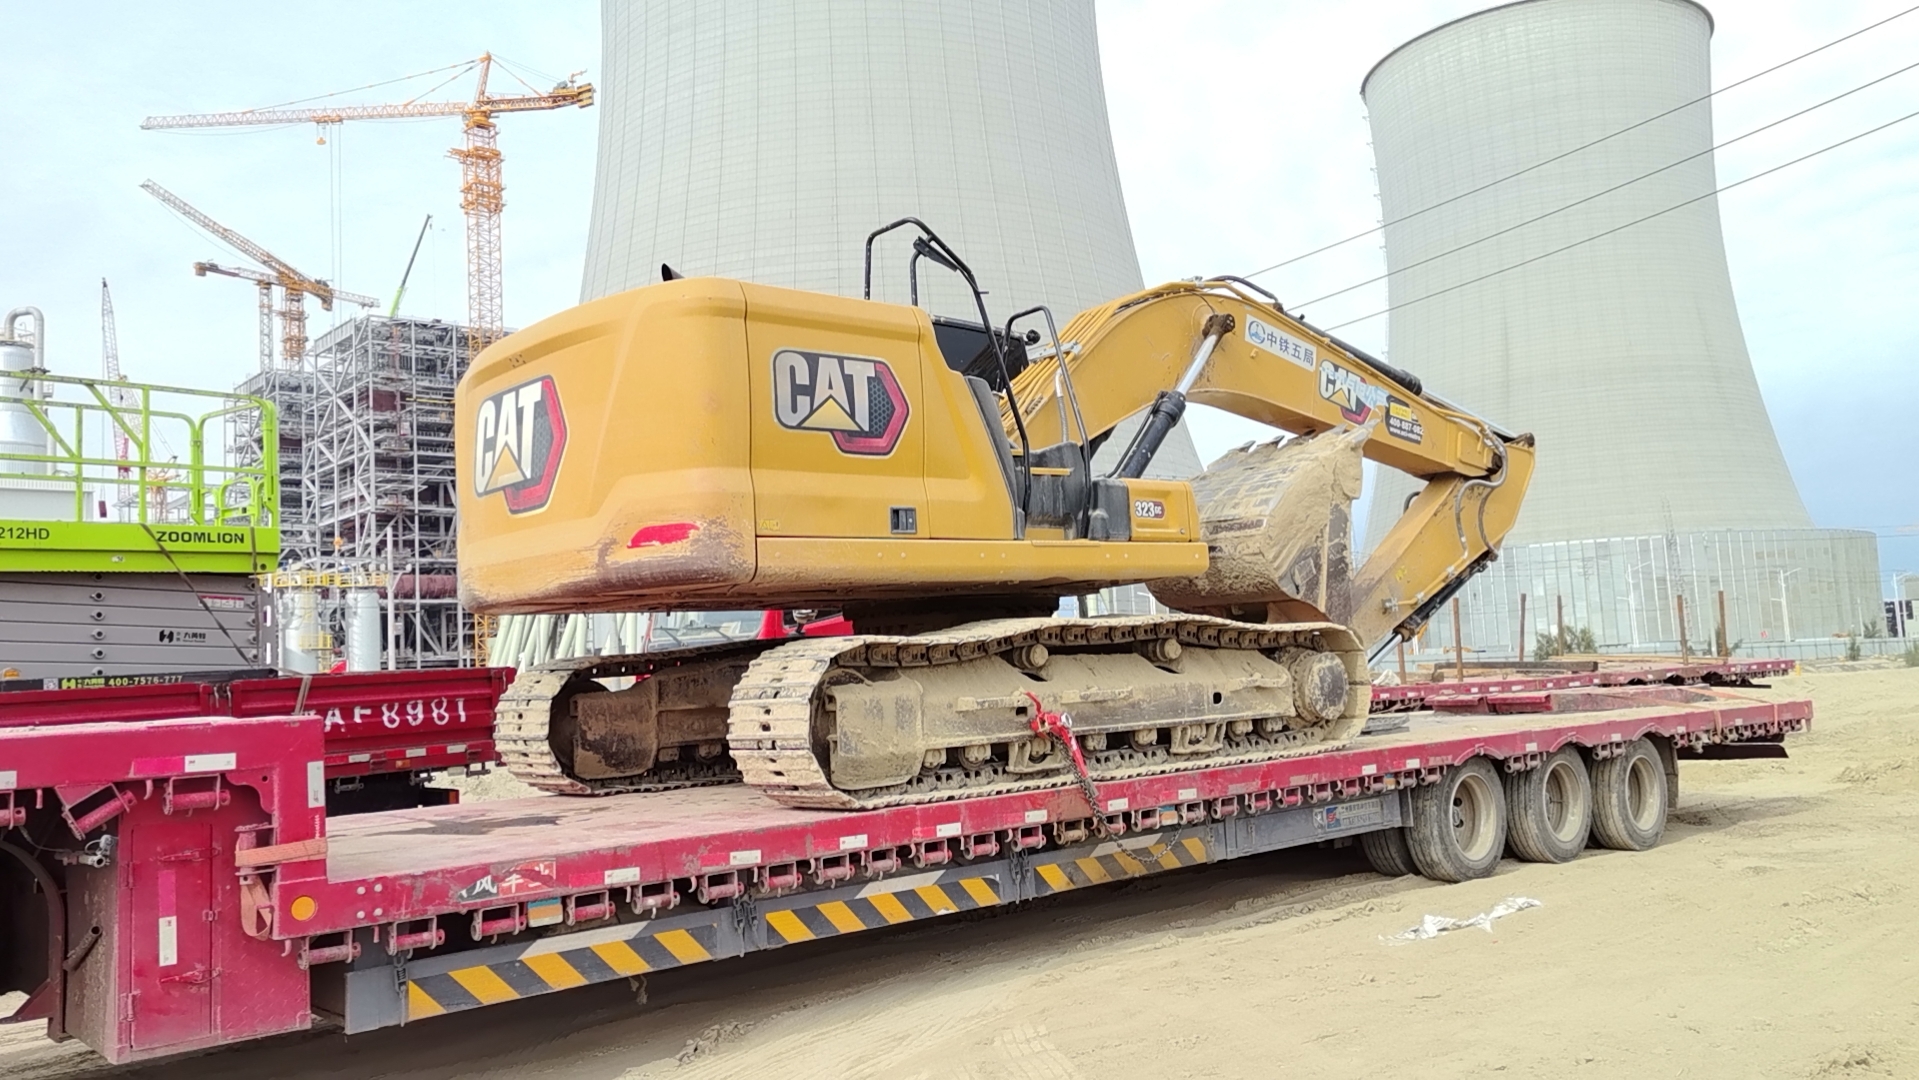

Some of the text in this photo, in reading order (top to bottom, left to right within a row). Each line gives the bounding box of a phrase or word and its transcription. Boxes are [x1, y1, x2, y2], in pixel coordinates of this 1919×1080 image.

[1266, 331, 1314, 367] 中铁五局
[776, 351, 876, 433] CAT
[476, 380, 542, 493] CAT
[1134, 500, 1155, 517] 323
[155, 530, 245, 544] ZOOMLION
[108, 675, 183, 687] 400-7576-777
